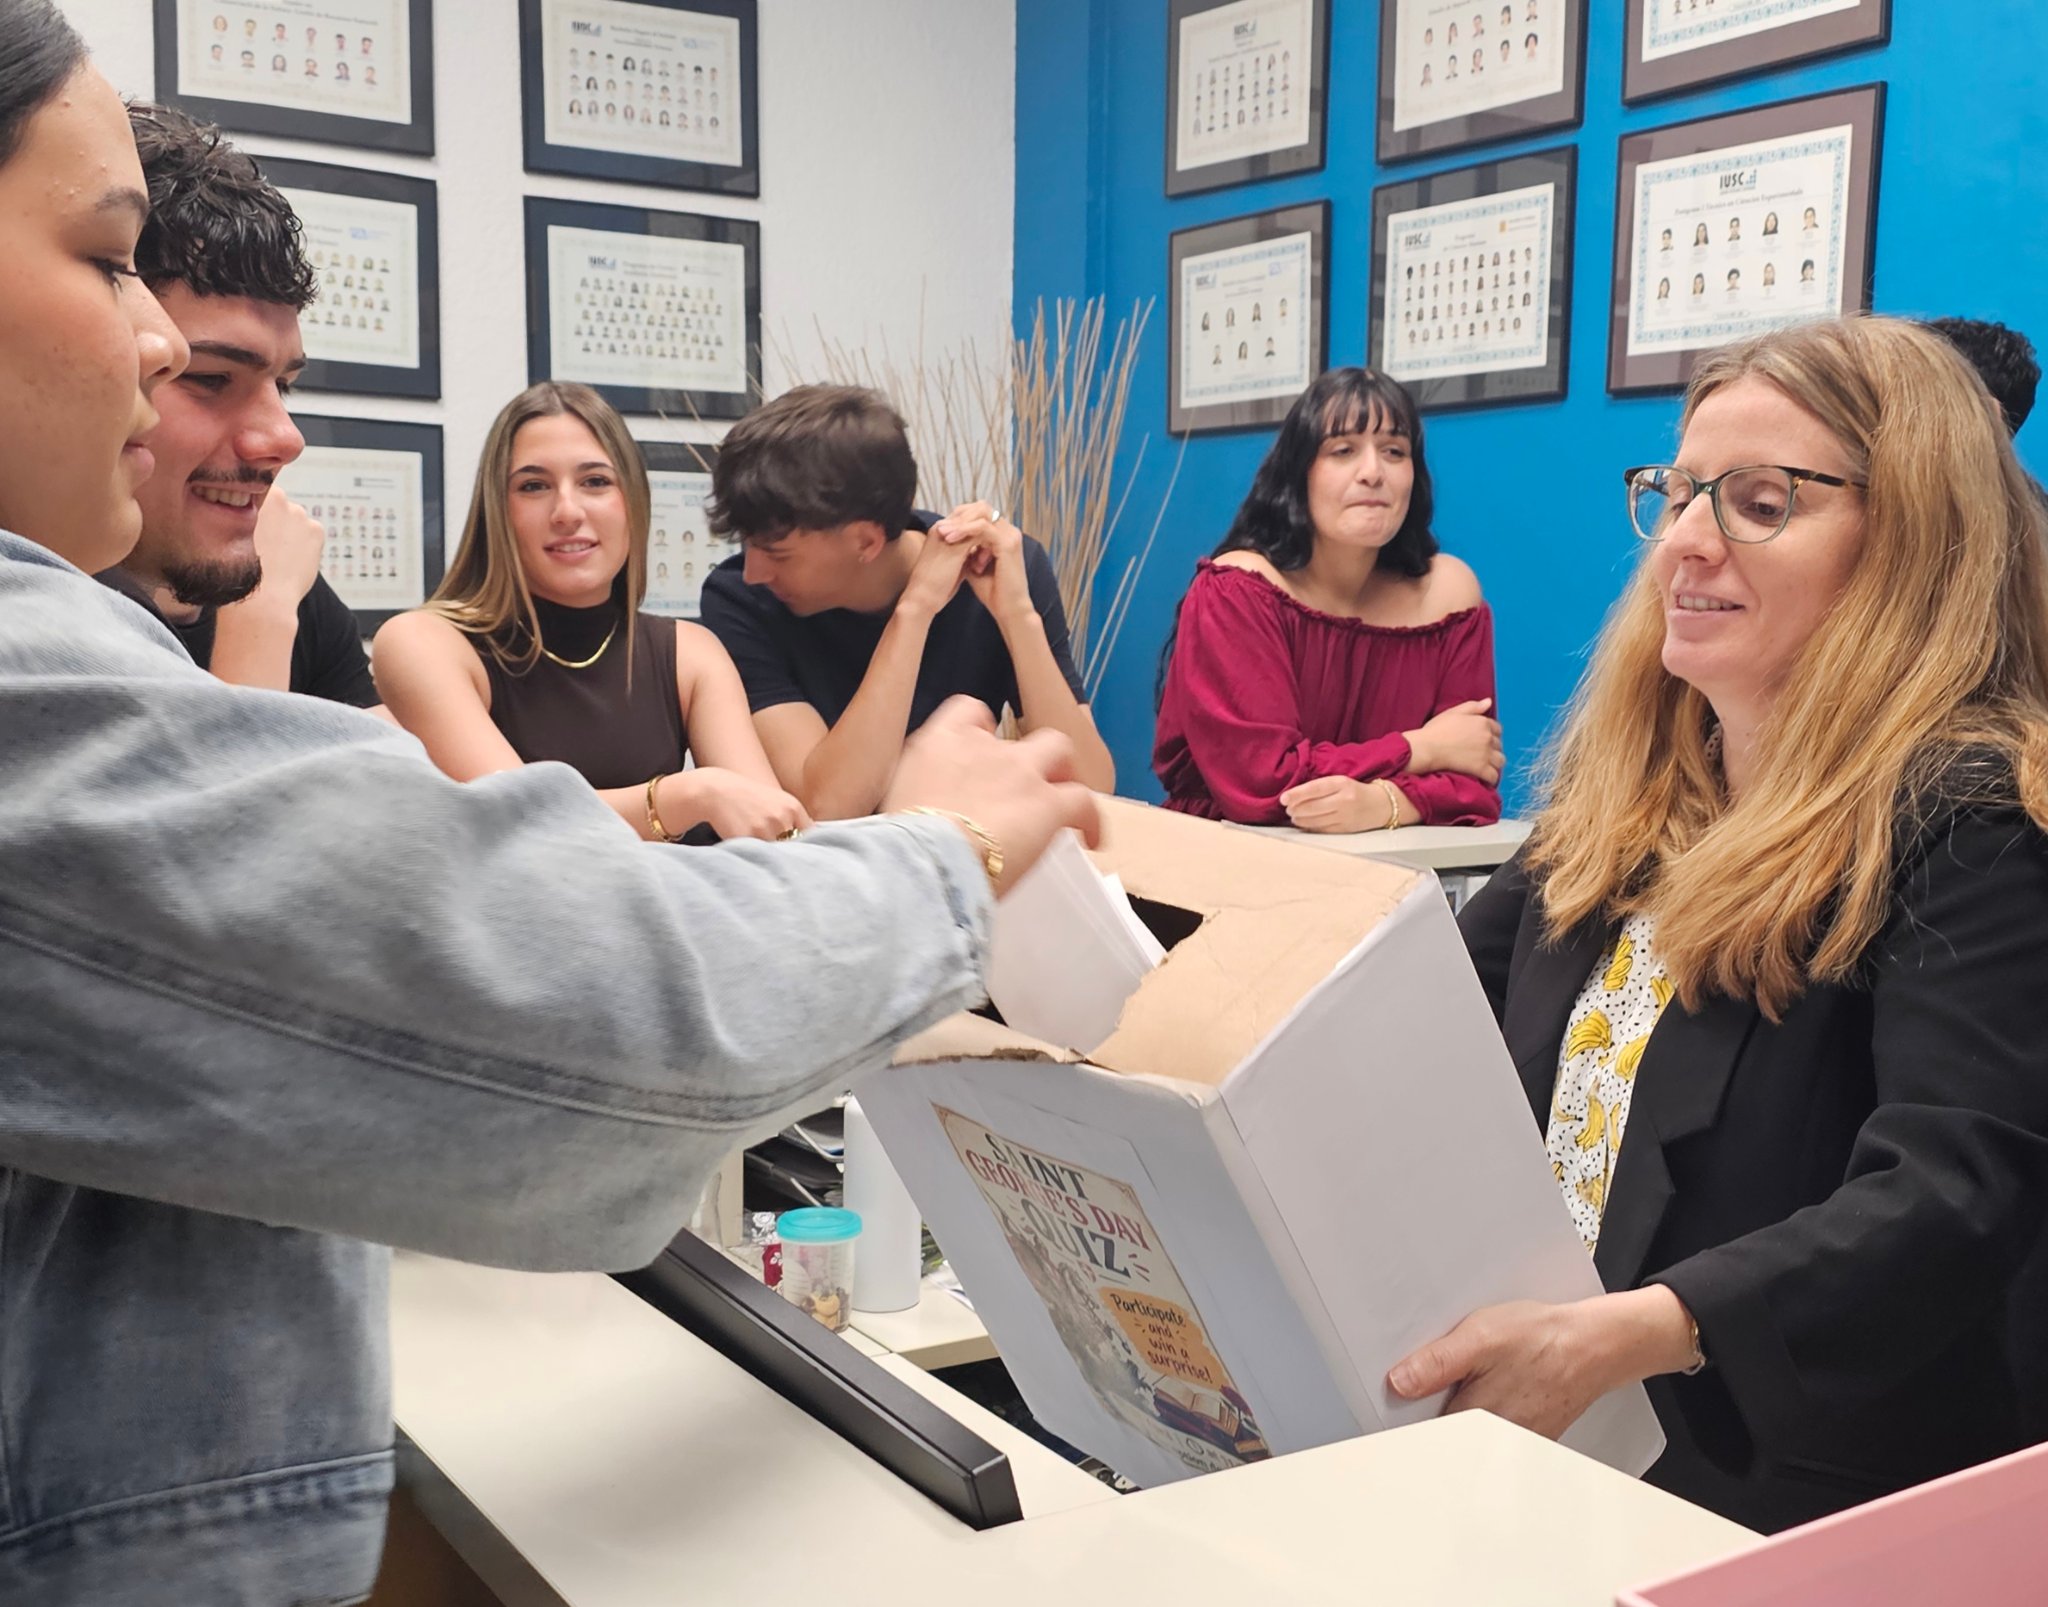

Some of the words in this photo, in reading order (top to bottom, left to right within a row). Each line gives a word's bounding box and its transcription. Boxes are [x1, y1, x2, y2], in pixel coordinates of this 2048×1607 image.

[1719, 171, 1745, 189] IUSC
[985, 1133, 1089, 1200] SAINT
[966, 1149, 1089, 1226] GEORGE'S
[1088, 1203, 1151, 1251] DAY
[1021, 1198, 1131, 1278] QUIZ
[1110, 1293, 1184, 1325] Participate
[1148, 1323, 1174, 1339] and
[1148, 1337, 1177, 1356] win
[1180, 1348, 1190, 1361] a
[1147, 1350, 1213, 1384] surprise!
